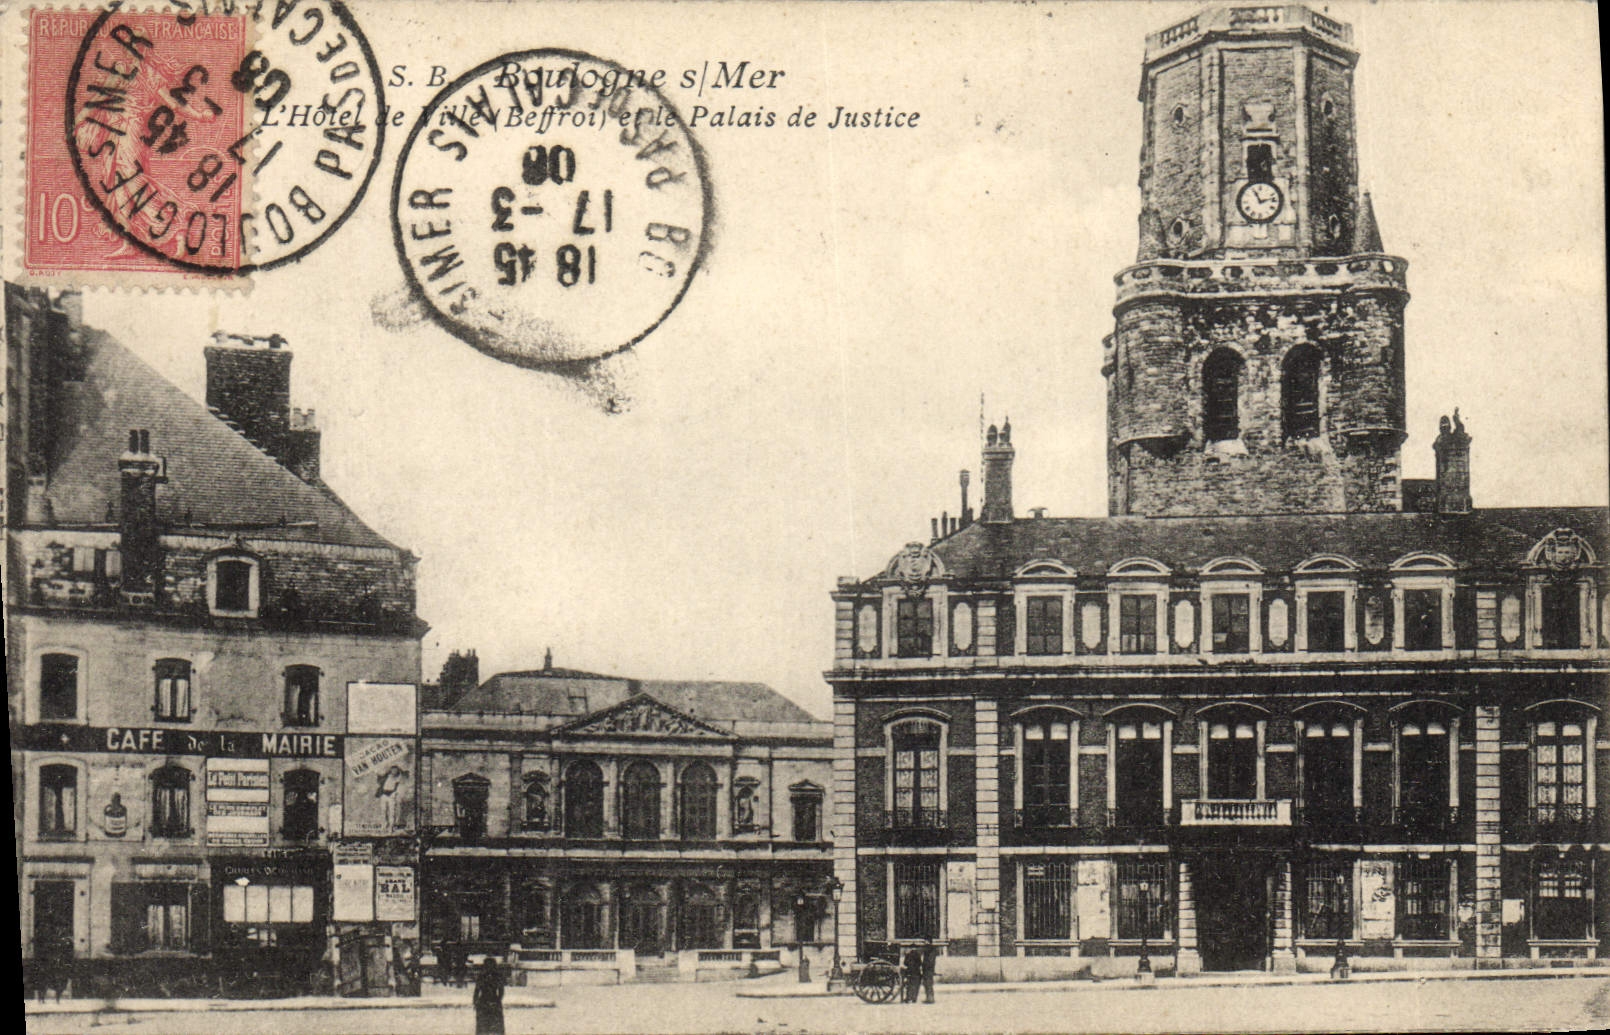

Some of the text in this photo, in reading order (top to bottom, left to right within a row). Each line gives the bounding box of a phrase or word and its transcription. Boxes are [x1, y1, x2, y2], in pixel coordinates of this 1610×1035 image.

[106, 727, 336, 756] CAFE de la MAIRIE
[352, 743, 403, 776] VAN HOUTEN
[379, 883, 411, 894] BAL
